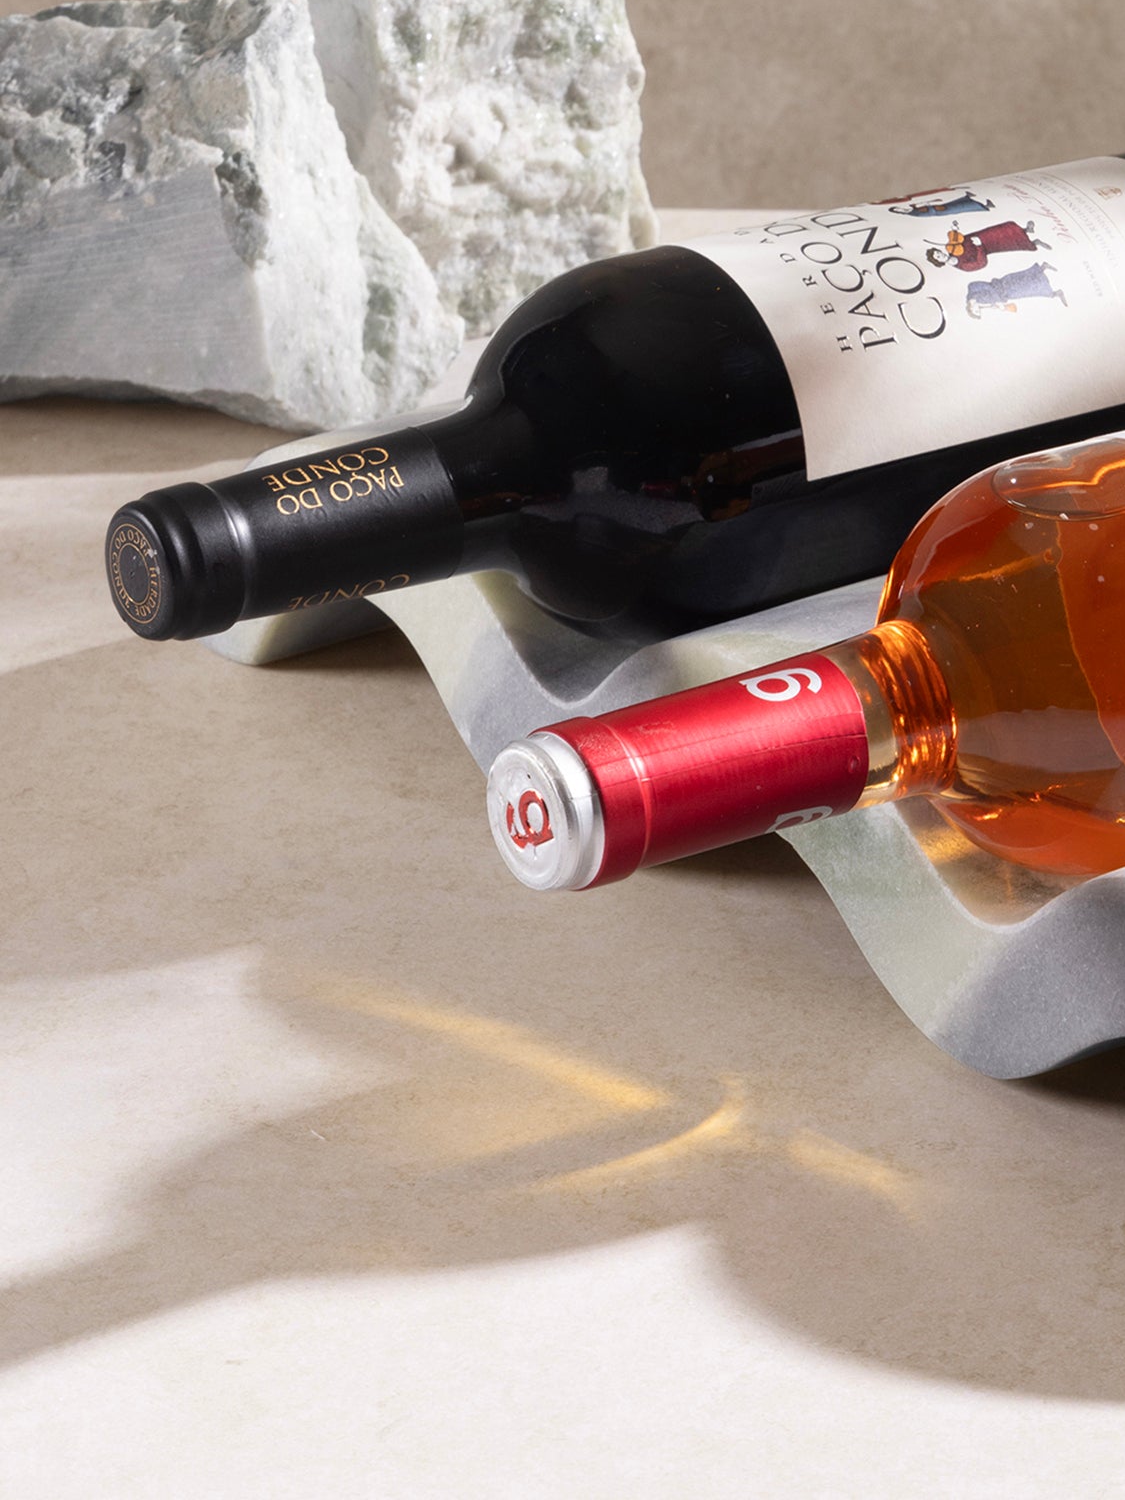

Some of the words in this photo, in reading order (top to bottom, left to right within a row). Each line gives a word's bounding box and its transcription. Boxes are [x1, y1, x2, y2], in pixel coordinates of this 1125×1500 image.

[733, 229, 852, 352] HERDAD
[800, 241, 900, 351] PAÇO
[810, 211, 947, 339] COND
[262, 447, 389, 492] CONDE
[276, 487, 323, 515] DO
[329, 466, 405, 502] PAÇO
